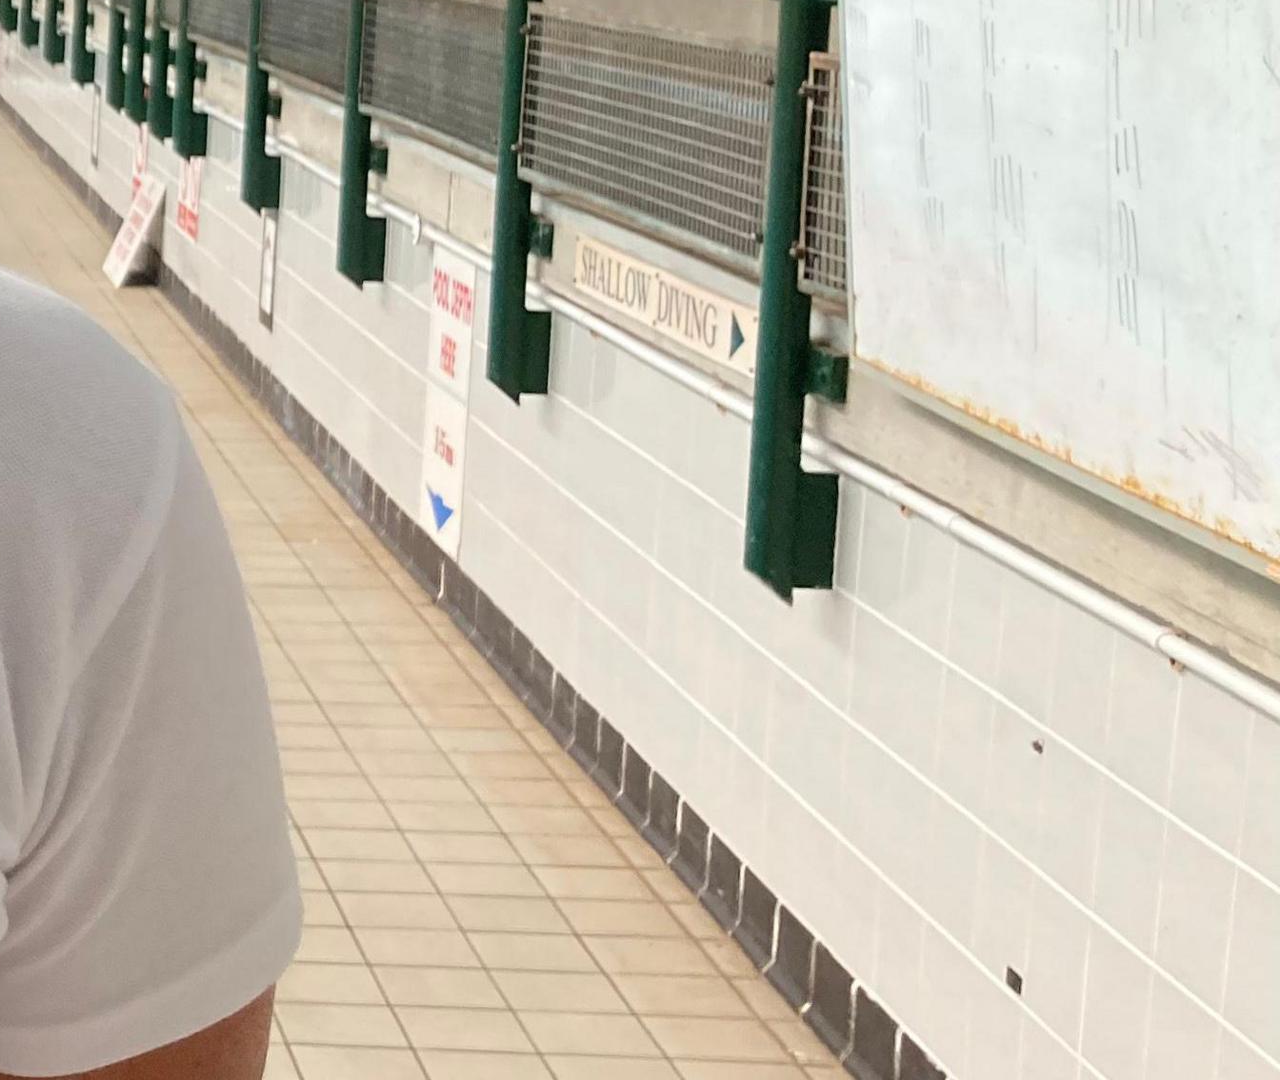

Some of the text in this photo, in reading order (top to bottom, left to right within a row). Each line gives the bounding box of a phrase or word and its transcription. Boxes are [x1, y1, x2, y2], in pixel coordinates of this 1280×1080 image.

[433, 268, 472, 325] POOL DEPTH
[582, 245, 718, 349] SHALLOW DIVING
